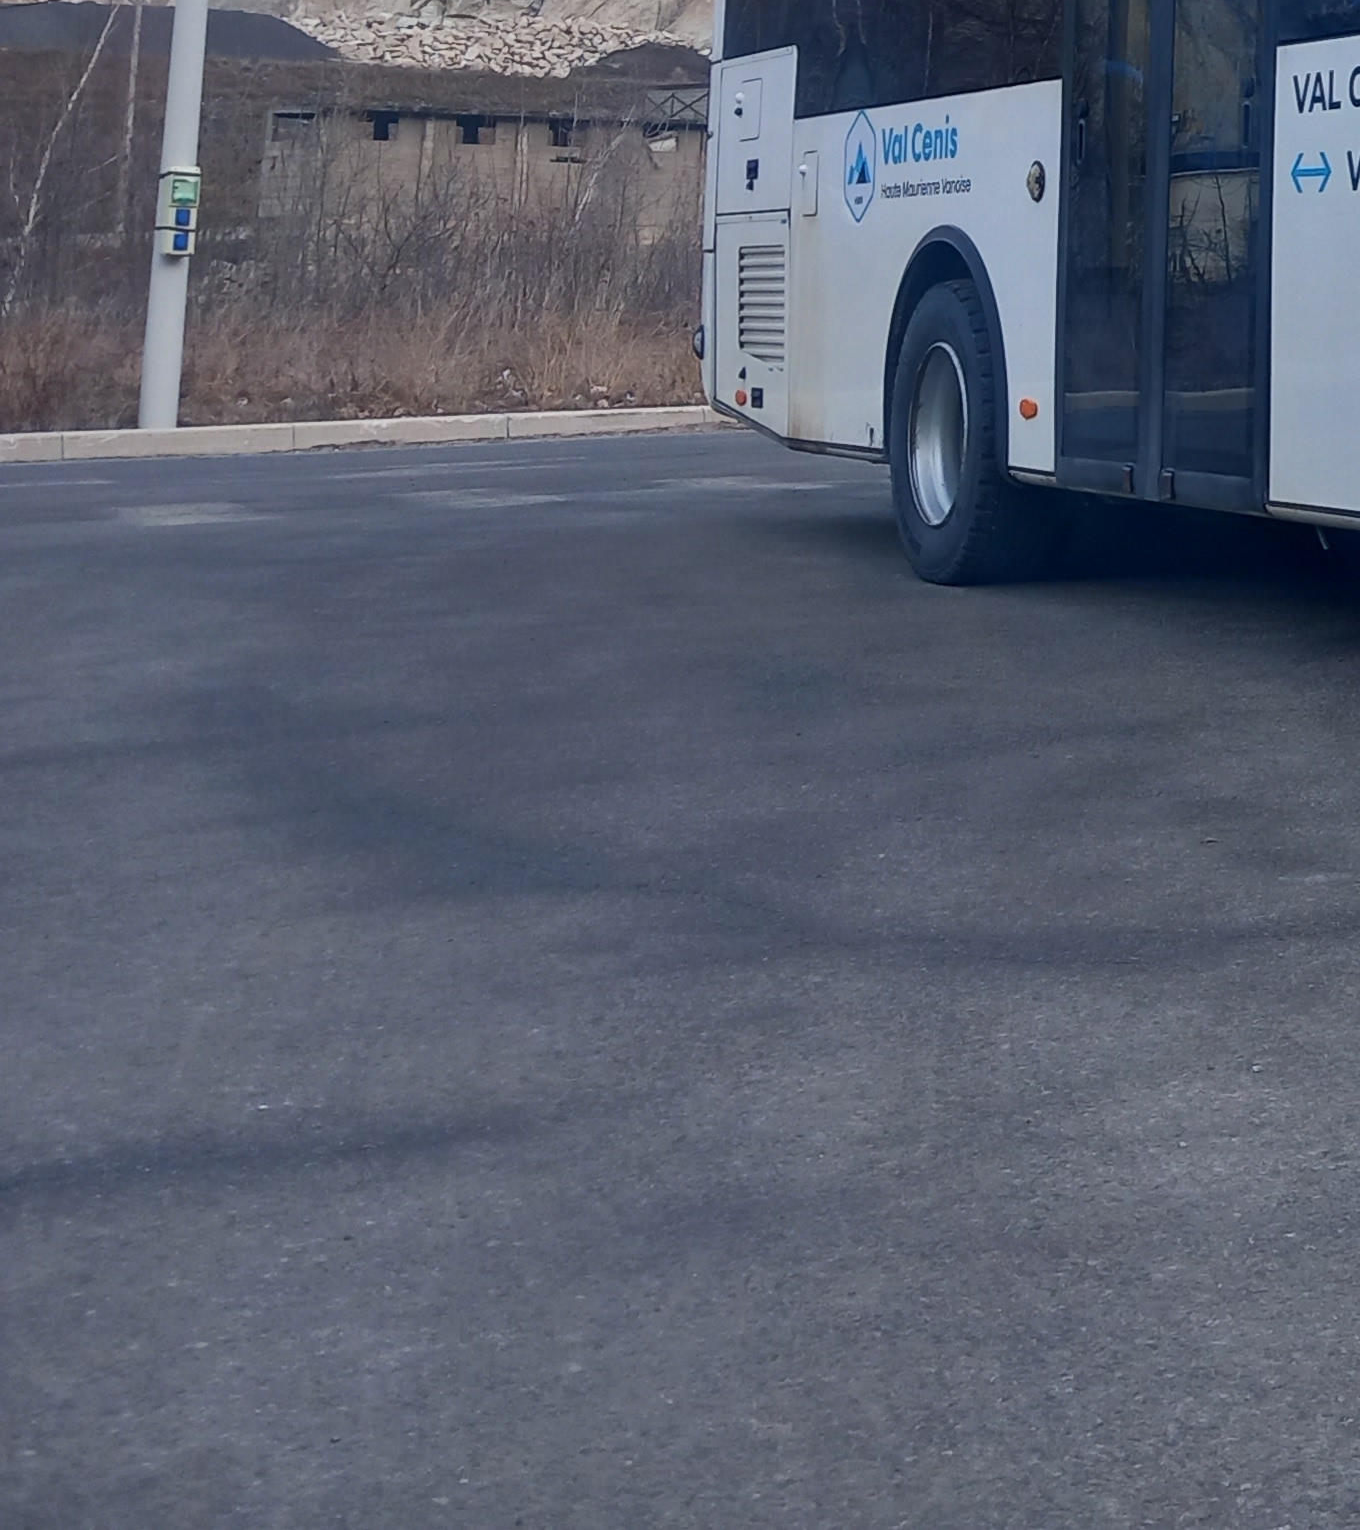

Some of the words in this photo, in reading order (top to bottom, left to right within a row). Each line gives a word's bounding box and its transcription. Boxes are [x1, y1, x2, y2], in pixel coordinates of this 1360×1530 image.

[1292, 70, 1341, 114] VAL
[881, 125, 908, 166] Val
[911, 114, 958, 163] Cenis
